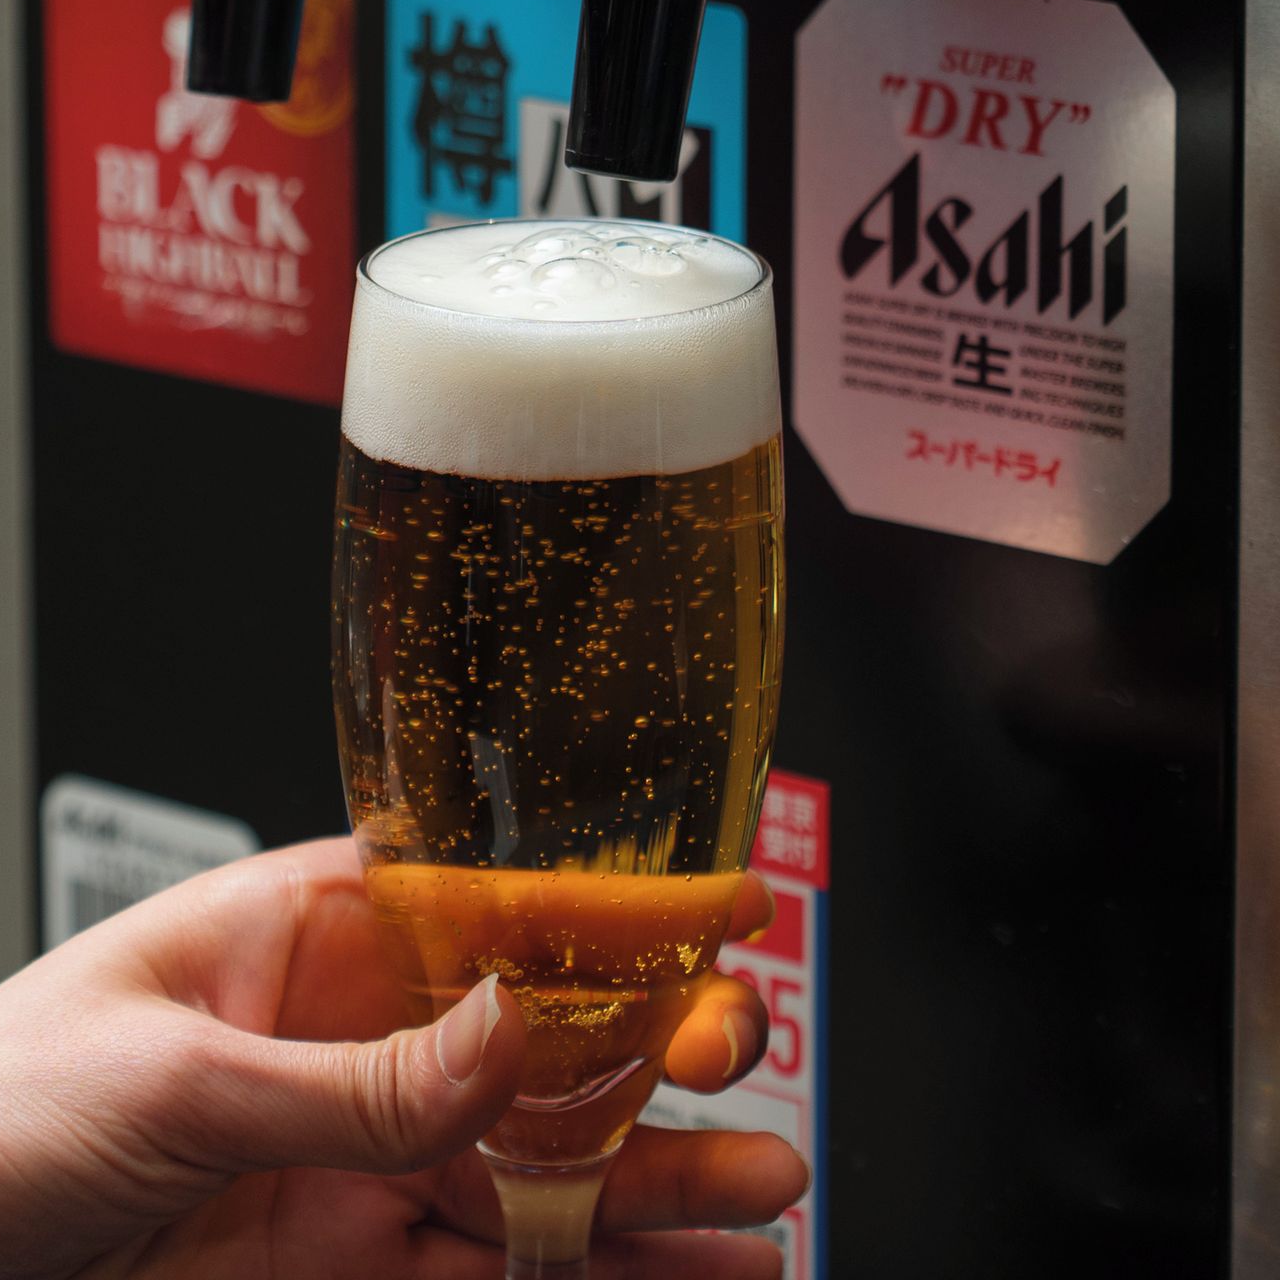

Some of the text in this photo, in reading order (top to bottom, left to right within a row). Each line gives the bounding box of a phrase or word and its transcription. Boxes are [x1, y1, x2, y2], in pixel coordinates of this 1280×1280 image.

[940, 45, 1035, 83] SUPER
[97, 144, 310, 255] BLACK
[840, 152, 1127, 326] Asahi
[953, 334, 1013, 395] 生
[906, 428, 1062, 488] スーパードライ
